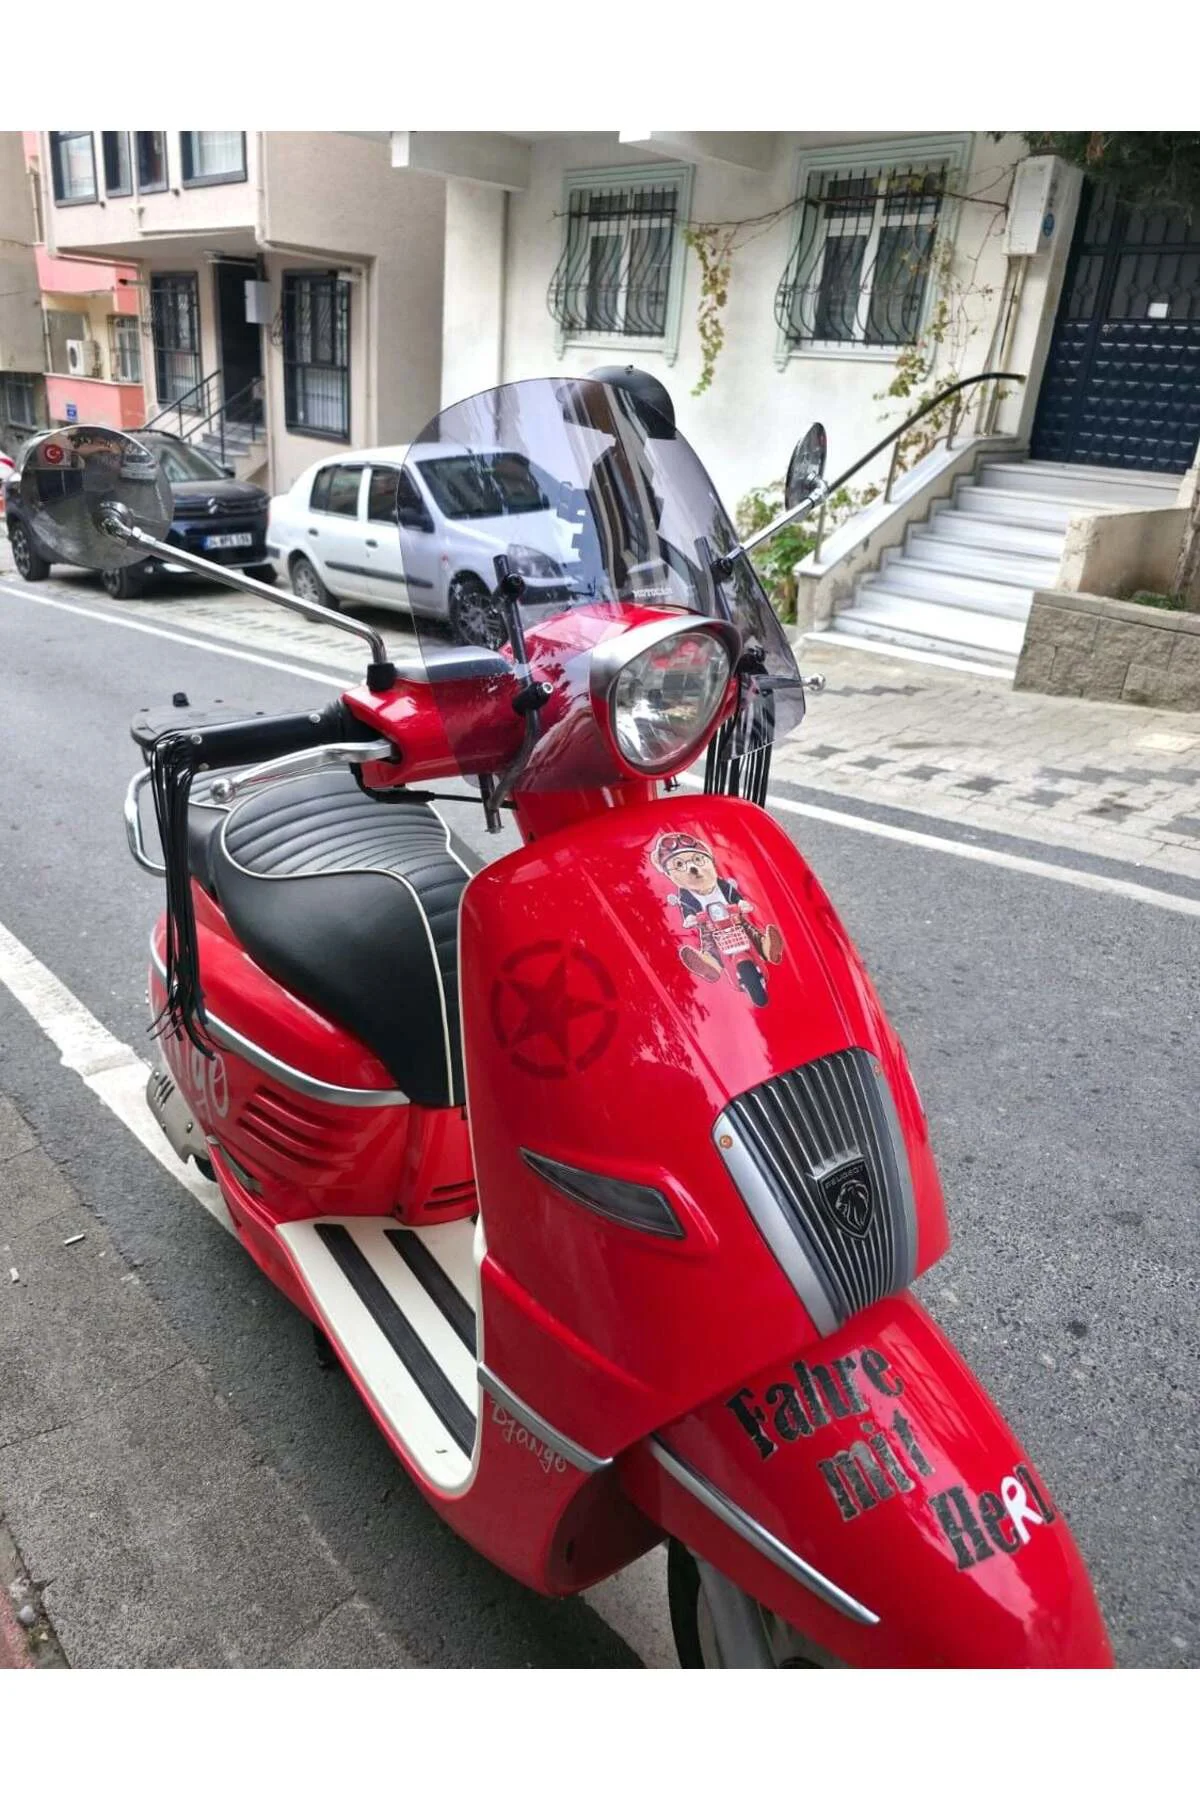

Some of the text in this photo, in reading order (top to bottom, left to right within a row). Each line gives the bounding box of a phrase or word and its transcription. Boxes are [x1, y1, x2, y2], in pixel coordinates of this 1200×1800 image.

[825, 1164, 863, 1189] PEUGEOT
[726, 1347, 905, 1460] Fahre
[818, 1408, 935, 1521] mit
